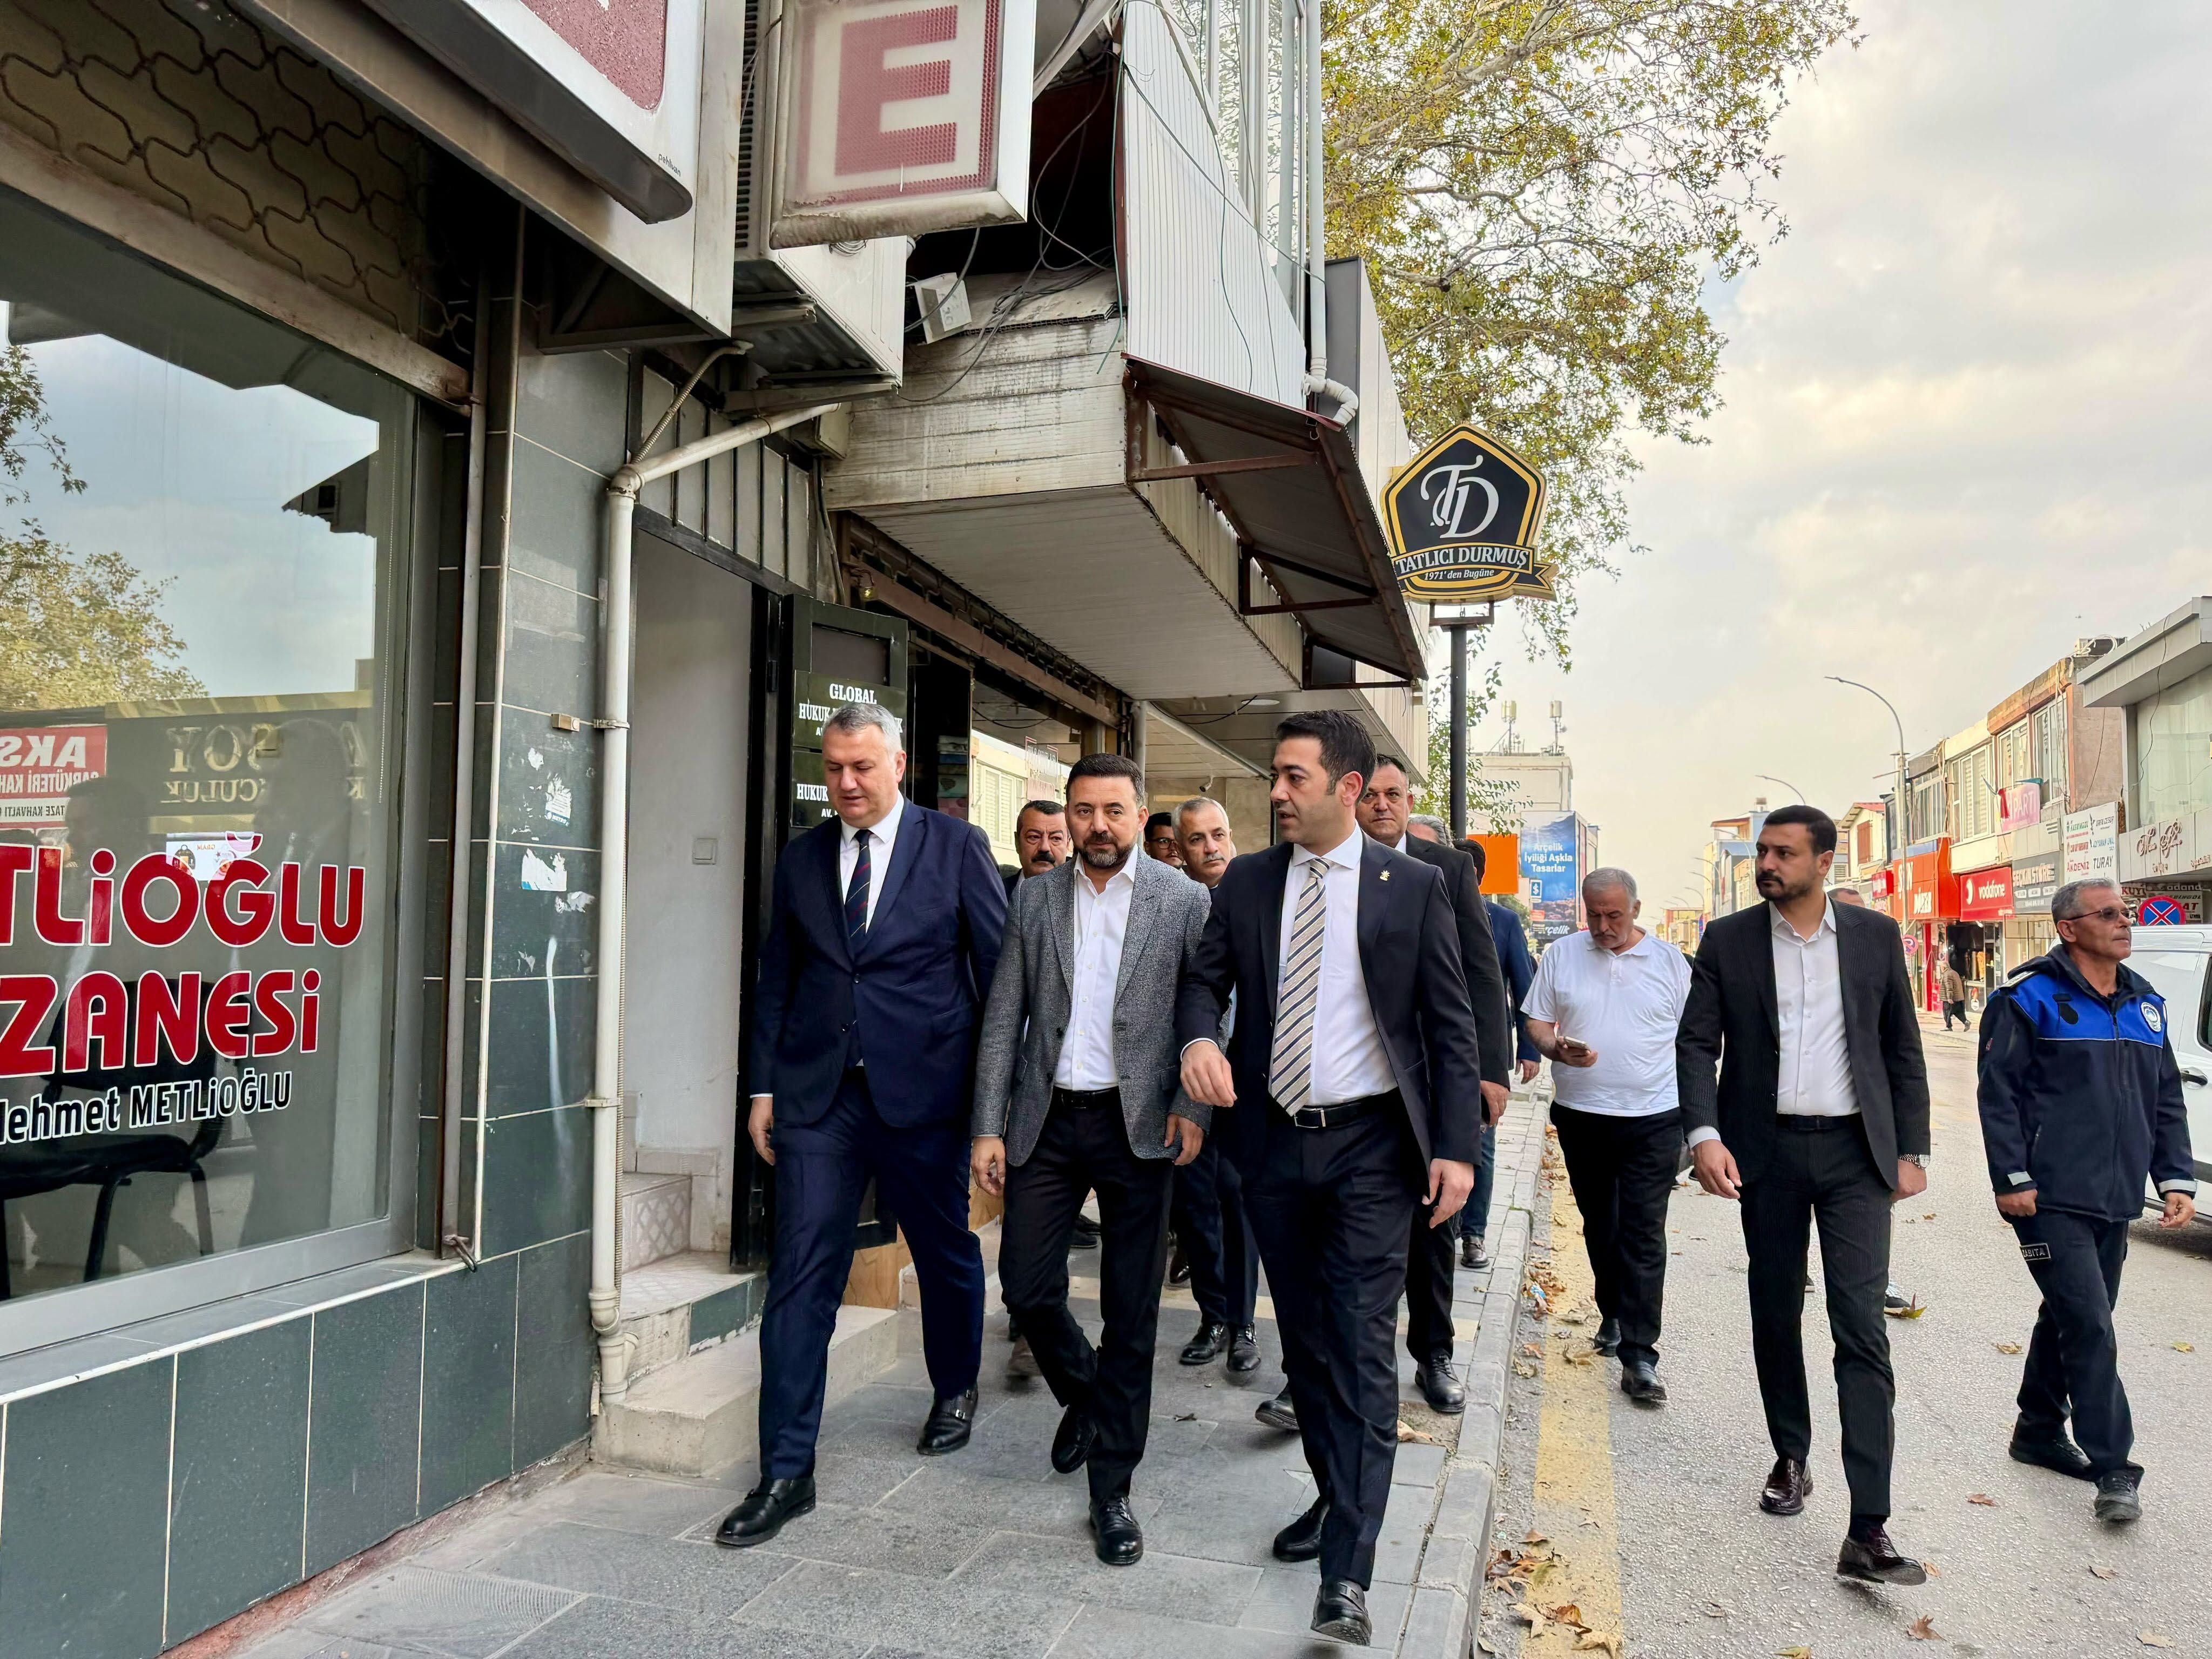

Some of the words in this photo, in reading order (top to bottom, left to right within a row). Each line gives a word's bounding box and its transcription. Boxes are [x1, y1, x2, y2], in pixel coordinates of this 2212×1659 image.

[1395, 547, 1454, 574] TATLICI
[1458, 546, 1529, 569] DURMUŞ
[1464, 569, 1494, 579] Bugüne
[829, 683, 877, 705] GLOBAL
[797, 784, 829, 801] HUKUK
[1534, 842, 1563, 854] Arçelik
[1524, 852, 1547, 864] İyiliği
[1549, 853, 1573, 865] Aşkla
[2093, 855, 2113, 869] TURAY
[1531, 864, 1566, 873] Tasarlar
[1898, 861, 1914, 900] ŞN
[1978, 880, 2006, 899] vodafone
